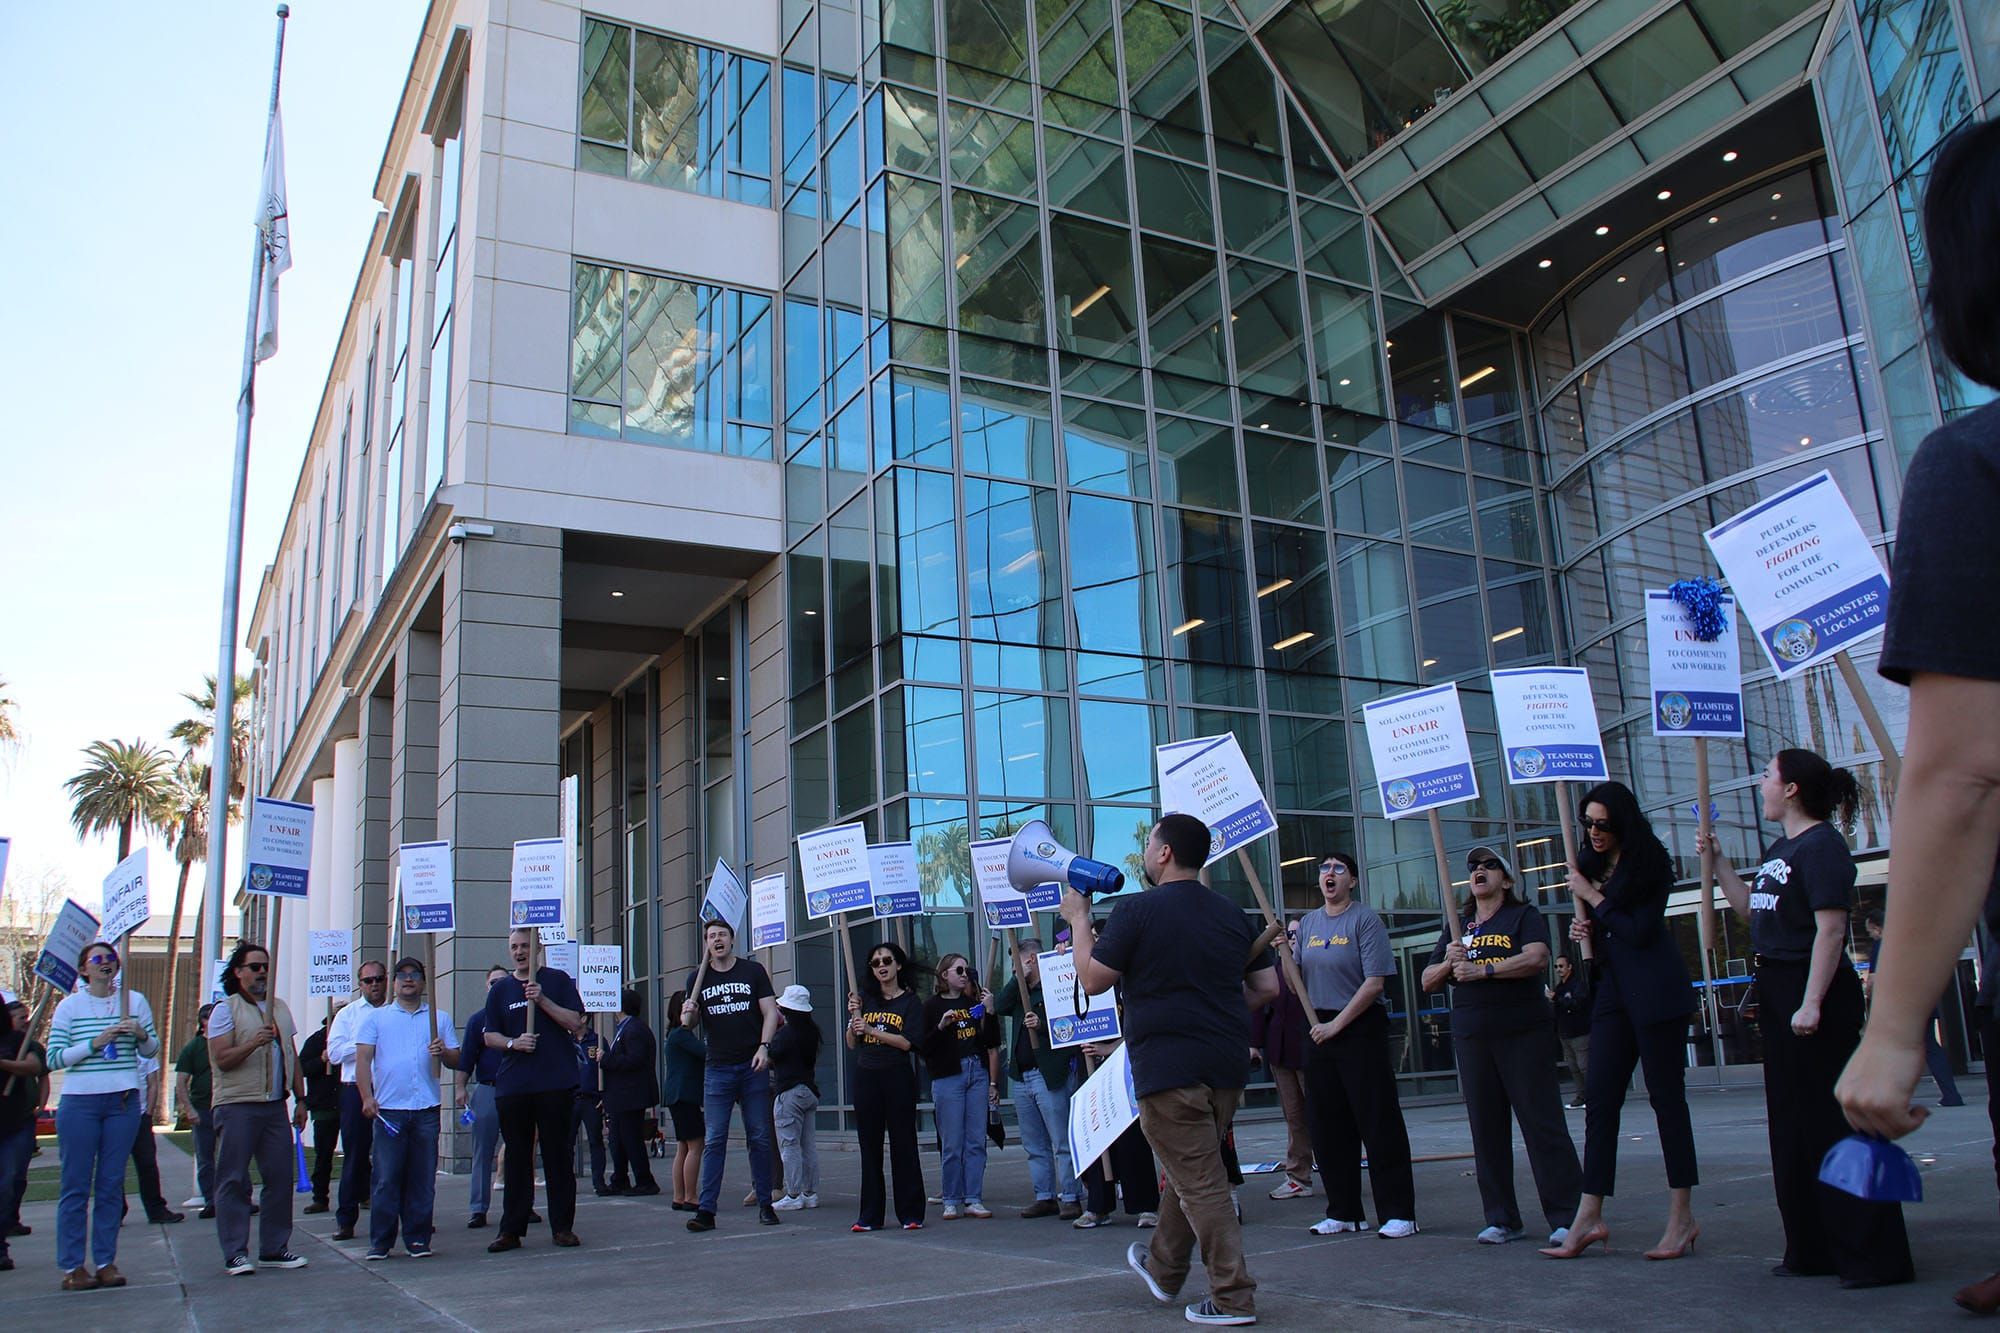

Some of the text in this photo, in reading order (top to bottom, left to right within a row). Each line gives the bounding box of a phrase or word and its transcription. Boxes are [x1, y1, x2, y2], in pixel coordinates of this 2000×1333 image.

[1759, 514, 1799, 540] PUBLIC
[1755, 522, 1818, 558] DEFENDERS
[1765, 534, 1821, 570] FIGHTING
[1777, 552, 1824, 581] FOR THE
[1774, 561, 1842, 600] COMMUNITY
[1812, 590, 1880, 628] TEAMSTERS
[1661, 614, 1694, 623] SOLAN
[1823, 604, 1880, 637] LOCAL 150
[1667, 649, 1727, 659] TO COMMUNITY
[1671, 662, 1726, 671] AND WORKERS
[1522, 693, 1569, 701] DEFENDERS
[1526, 702, 1569, 711] FIGHTING
[1693, 702, 1734, 711] TEAMSTERS
[1378, 704, 1447, 727] SOLANO COUNTY
[1696, 713, 1732, 722] LOCAL 150
[1392, 719, 1439, 740] UNFAIR
[1525, 723, 1576, 732] COMMUNITY
[1387, 733, 1450, 754] TO COMMUNITY
[1392, 744, 1451, 763] AND WORKERS
[1546, 752, 1595, 760] TEAMSTERS
[1193, 761, 1216, 778] PUBLIC
[1551, 761, 1580, 769] LOCAL
[1191, 766, 1227, 789] DEFENDERS
[1416, 773, 1464, 790] TEAMSTERS
[1196, 774, 1230, 796] FIGHTING
[1421, 783, 1462, 798] LOCAL 150
[1203, 786, 1230, 804] FOR THE
[1202, 791, 1241, 816] COMMUNITY
[1222, 810, 1262, 834] TEAMSTERS
[269, 825, 302, 837] UNFAIR
[1228, 818, 1263, 840] LOCAL 150
[271, 838, 304, 847] COMMUNITY
[808, 838, 855, 852] SOLANO COUNTY
[817, 847, 850, 861] UNFAIR
[524, 864, 550, 873] UNFAIR
[820, 858, 857, 870] COMMUNITY
[983, 864, 1006, 873] UNFAIR
[274, 873, 304, 881] TEAMSTERS
[828, 866, 857, 877] WORKERS
[275, 880, 293, 888] LOCAL
[105, 874, 144, 913] UNFAIR
[831, 888, 865, 899] TEAMSTERS
[835, 896, 854, 904] LOCAL
[1028, 897, 1046, 905] LOCAL
[103, 894, 148, 932] TEAMSTERS
[131, 906, 149, 921] 150
[999, 906, 1023, 914] TEAMSTERS
[551, 931, 566, 941] 150
[1306, 934, 1350, 949] Teamters
[1471, 934, 1512, 949] STERS
[313, 954, 348, 966] UNFAIR
[582, 965, 620, 974] UNFAIR
[311, 974, 351, 983] TEAMSTERS
[311, 985, 351, 994] LOCAL 150
[701, 983, 751, 1001] TEAMSTERS
[1054, 988, 1062, 996] TO
[707, 1001, 750, 1015] EVERYBODY
[1074, 1015, 1110, 1027] TEAMSTERS
[1077, 1026, 1099, 1034] LOCAL
